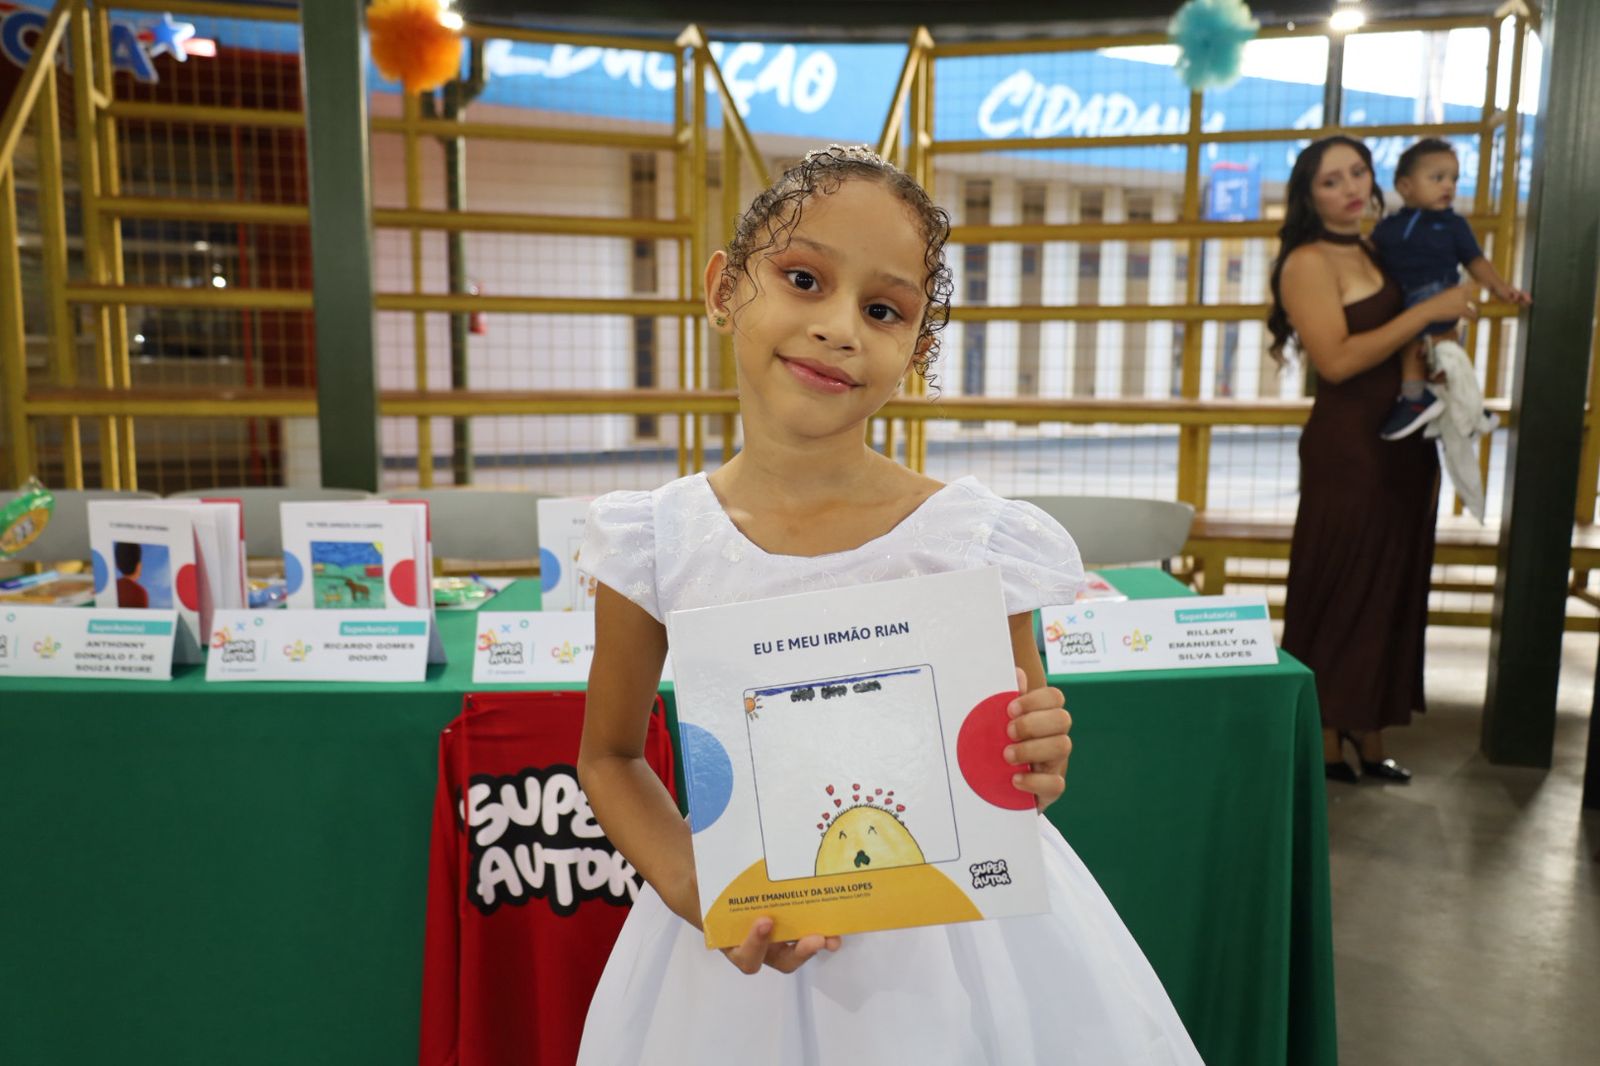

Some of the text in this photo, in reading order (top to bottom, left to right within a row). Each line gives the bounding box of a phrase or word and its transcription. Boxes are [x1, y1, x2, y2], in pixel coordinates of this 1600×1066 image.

[753, 621, 909, 655] EU E MEU IRMÃO RIAN
[1186, 628, 1235, 637] RILLARY
[86, 640, 145, 649] ANTHONNY
[323, 642, 415, 650] RICARDO GOMES
[1168, 638, 1257, 650] EMANUELLY DA
[74, 652, 126, 661] GONÇALO
[141, 653, 155, 662] DE
[1178, 650, 1252, 661] SILVA LOPES
[76, 664, 152, 674] SOUZA FREIRE
[459, 772, 606, 847] SUPE
[970, 860, 1007, 878] SUPER
[972, 872, 1011, 888] AUTOR
[728, 895, 760, 906] RILLARY
[761, 888, 808, 902] EMANUELLY
[811, 887, 823, 896] DA
[824, 885, 846, 895] SILVA
[848, 882, 873, 892] LOPES
